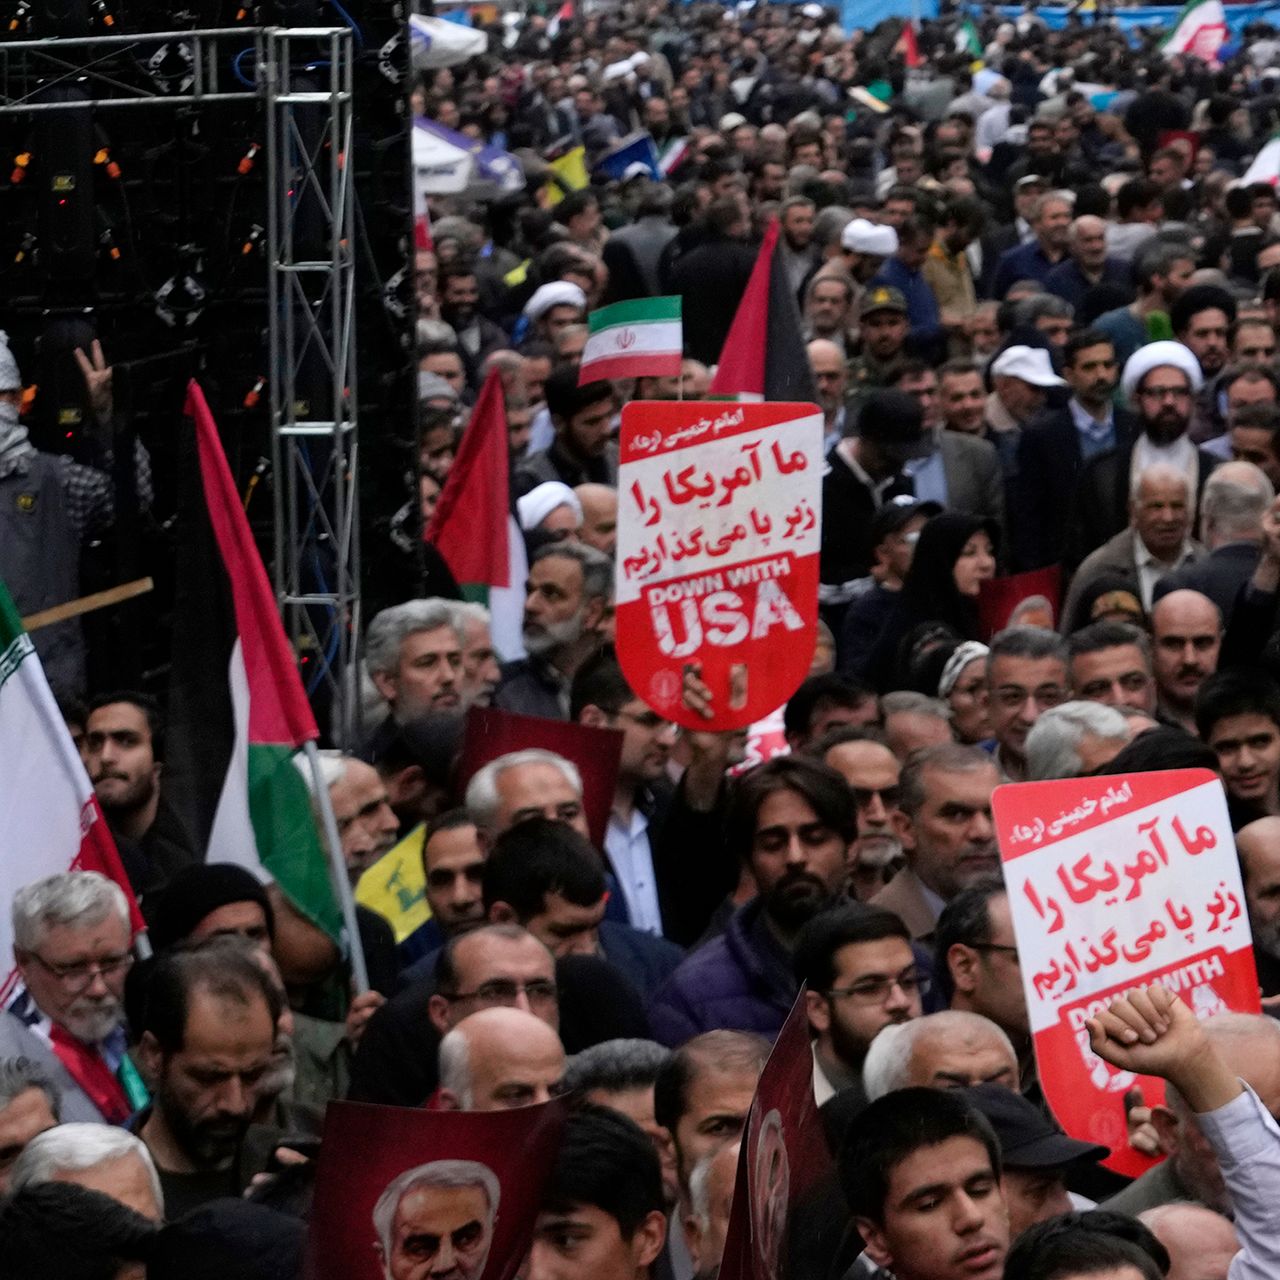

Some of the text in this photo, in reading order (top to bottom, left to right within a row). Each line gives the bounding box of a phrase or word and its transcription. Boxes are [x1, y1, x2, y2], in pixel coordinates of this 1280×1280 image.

[630, 439, 808, 527] ما آمریکا را
[750, 507, 772, 546] پا
[782, 499, 816, 540] زیر
[648, 557, 791, 606] DOWN WITH
[651, 578, 805, 659] USA
[1047, 796, 1098, 836] خمینی
[1100, 781, 1133, 815] امام
[1023, 814, 1217, 934] ما آمریکا را
[1165, 897, 1194, 944] پا
[1206, 881, 1242, 933] زیر
